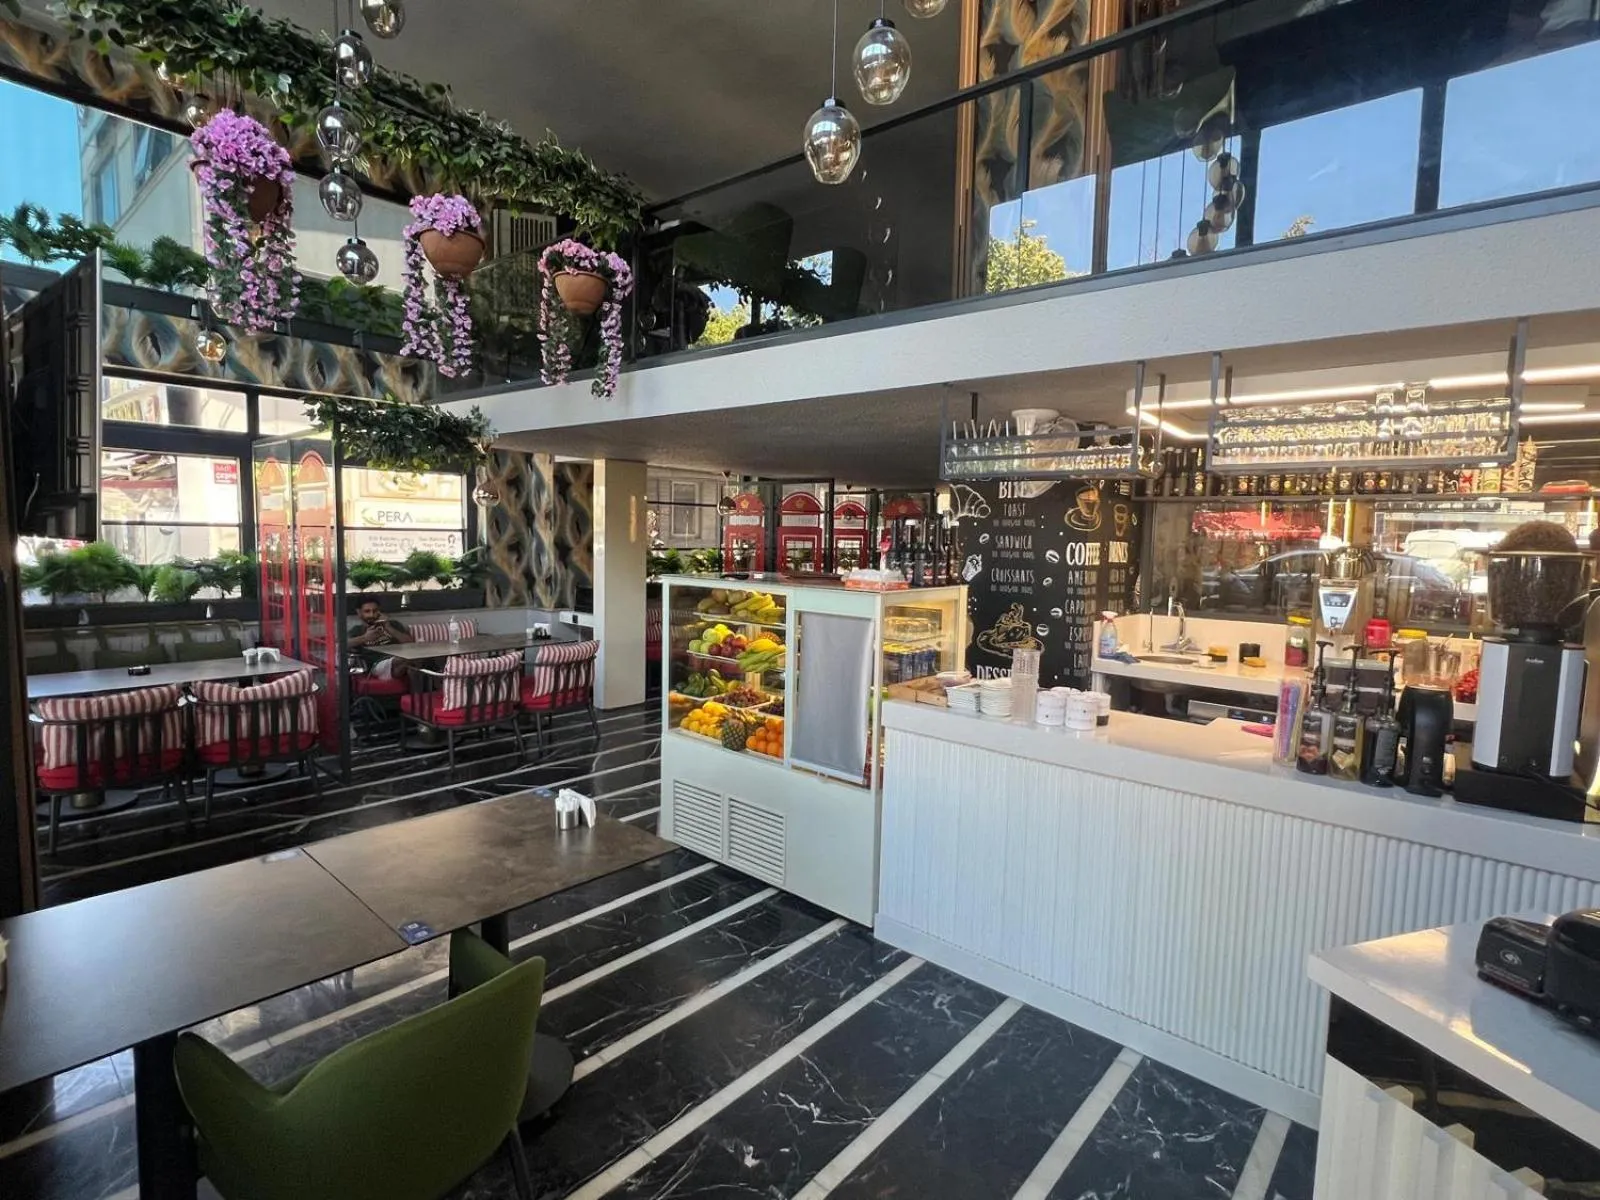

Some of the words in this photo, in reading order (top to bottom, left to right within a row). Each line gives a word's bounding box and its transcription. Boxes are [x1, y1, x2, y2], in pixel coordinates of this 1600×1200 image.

[377, 510, 413, 523] PERA
[1004, 503, 1026, 517] TOAST
[1066, 542, 1101, 566] COFFEE
[991, 567, 1035, 584] CROISSANTS
